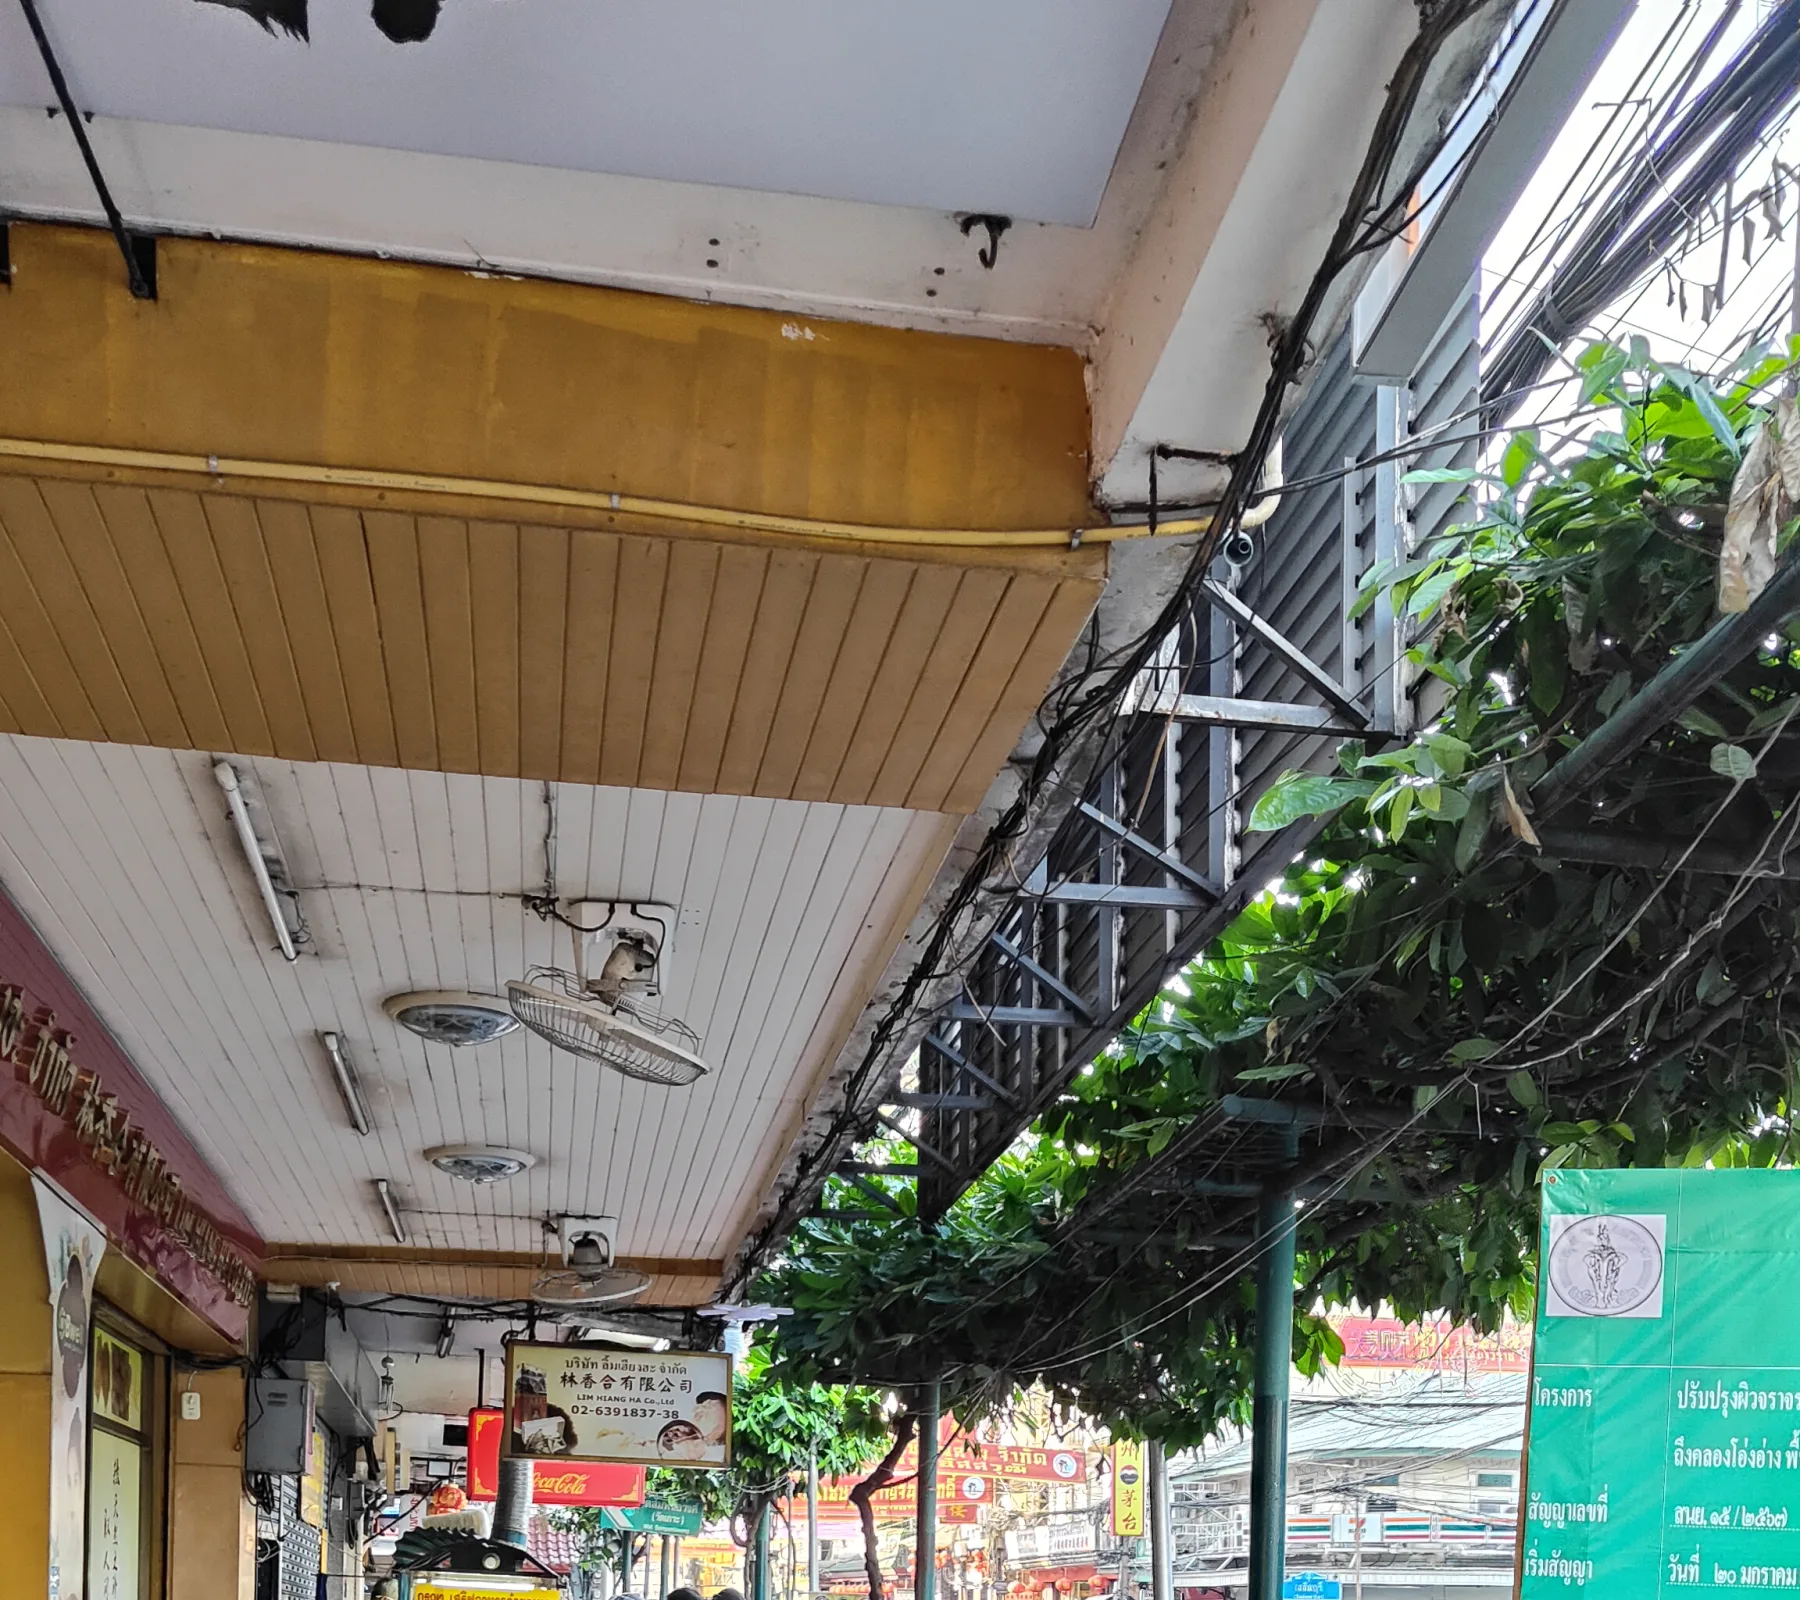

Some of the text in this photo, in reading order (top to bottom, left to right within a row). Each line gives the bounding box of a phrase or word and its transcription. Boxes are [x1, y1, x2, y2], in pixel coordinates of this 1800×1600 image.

[565, 1356, 599, 1370] บริษัท
[659, 1362, 687, 1375] จำกัด
[560, 1371, 693, 1394] 林香合有限公司
[1533, 1376, 1593, 1408] โครงการ
[571, 1404, 679, 1419] 02-6391837-38
[577, 1394, 594, 1402] LIM
[628, 1397, 642, 1405] HA
[1673, 1435, 1782, 1470] ถึงคลองโอ่งอ่าง
[1530, 1483, 1608, 1529] สัญญาเลขที่
[1524, 1539, 1594, 1586] เริ่มสัญญา
[1667, 1543, 1798, 1588] วันที่ ๒๐ มกราคม
